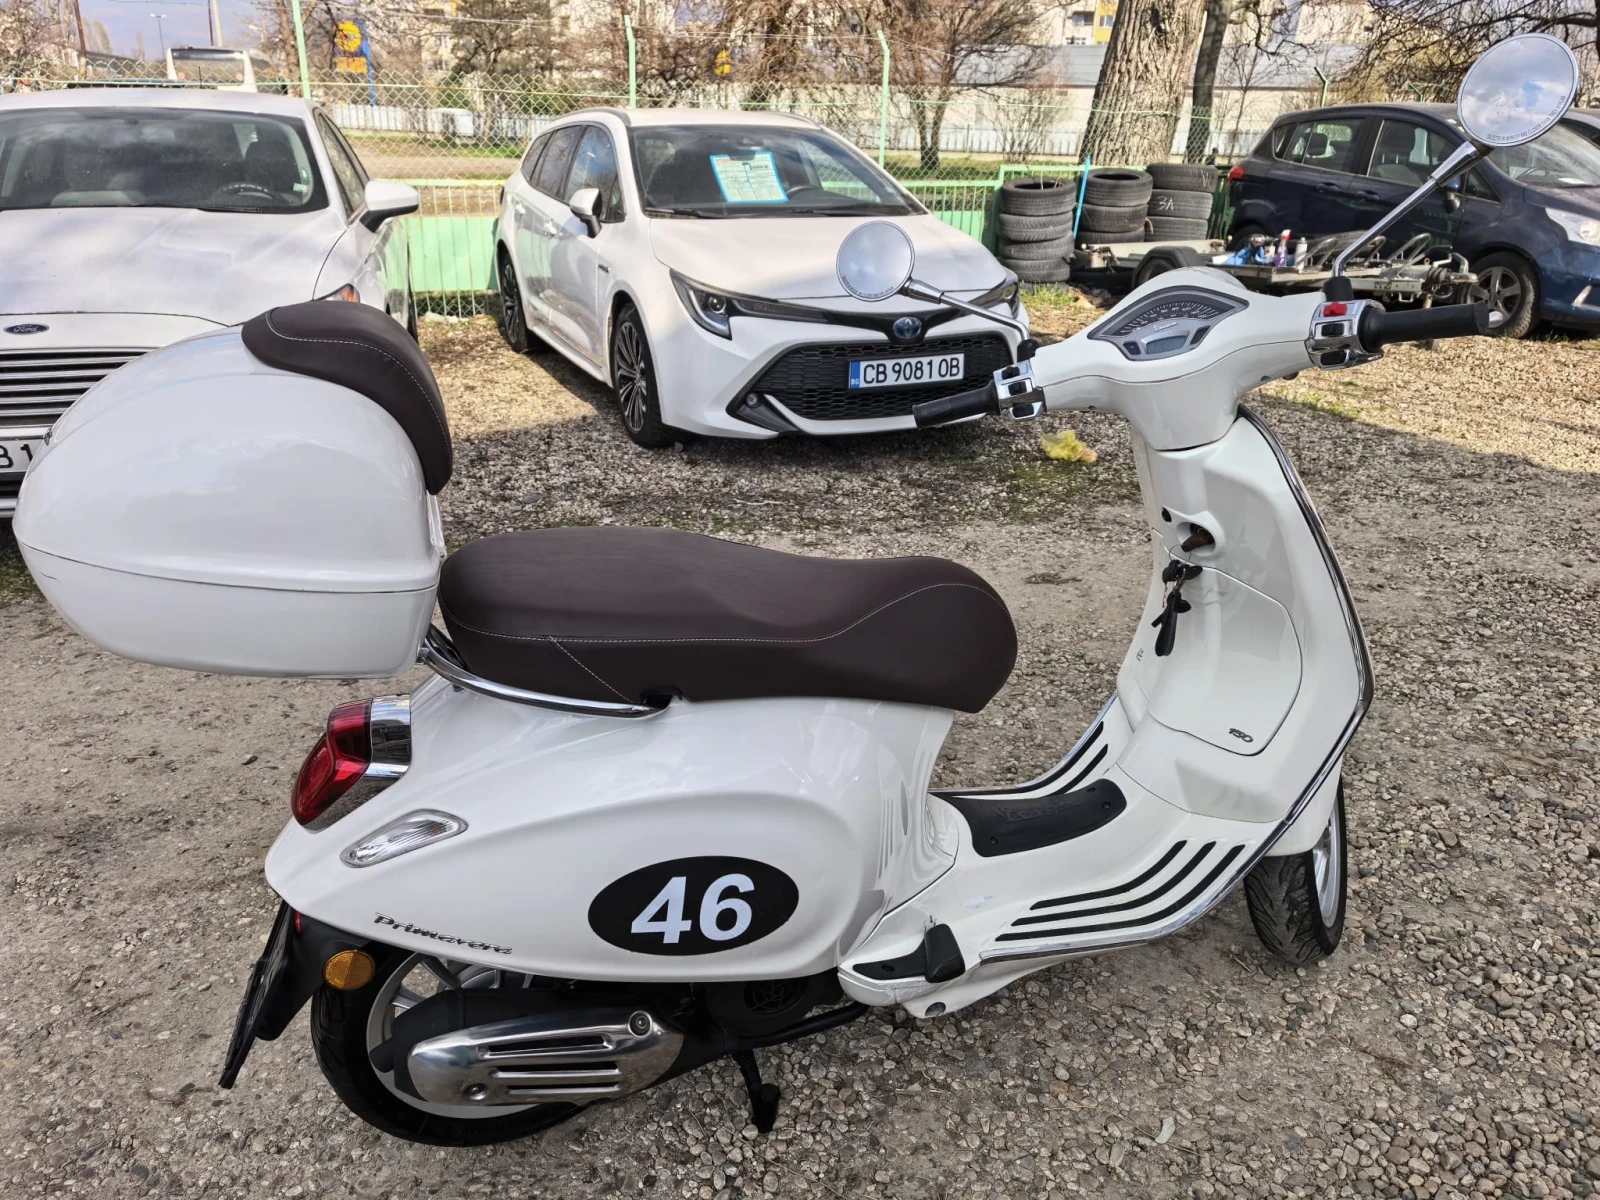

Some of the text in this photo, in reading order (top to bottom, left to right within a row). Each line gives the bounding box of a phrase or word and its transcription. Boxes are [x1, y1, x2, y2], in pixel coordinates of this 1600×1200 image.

[13, 325, 39, 333] Ford
[863, 363, 888, 385] CB
[891, 358, 934, 383] 9081
[1228, 727, 1254, 743] 150
[630, 872, 756, 944] 46
[373, 911, 513, 955] Primavera
